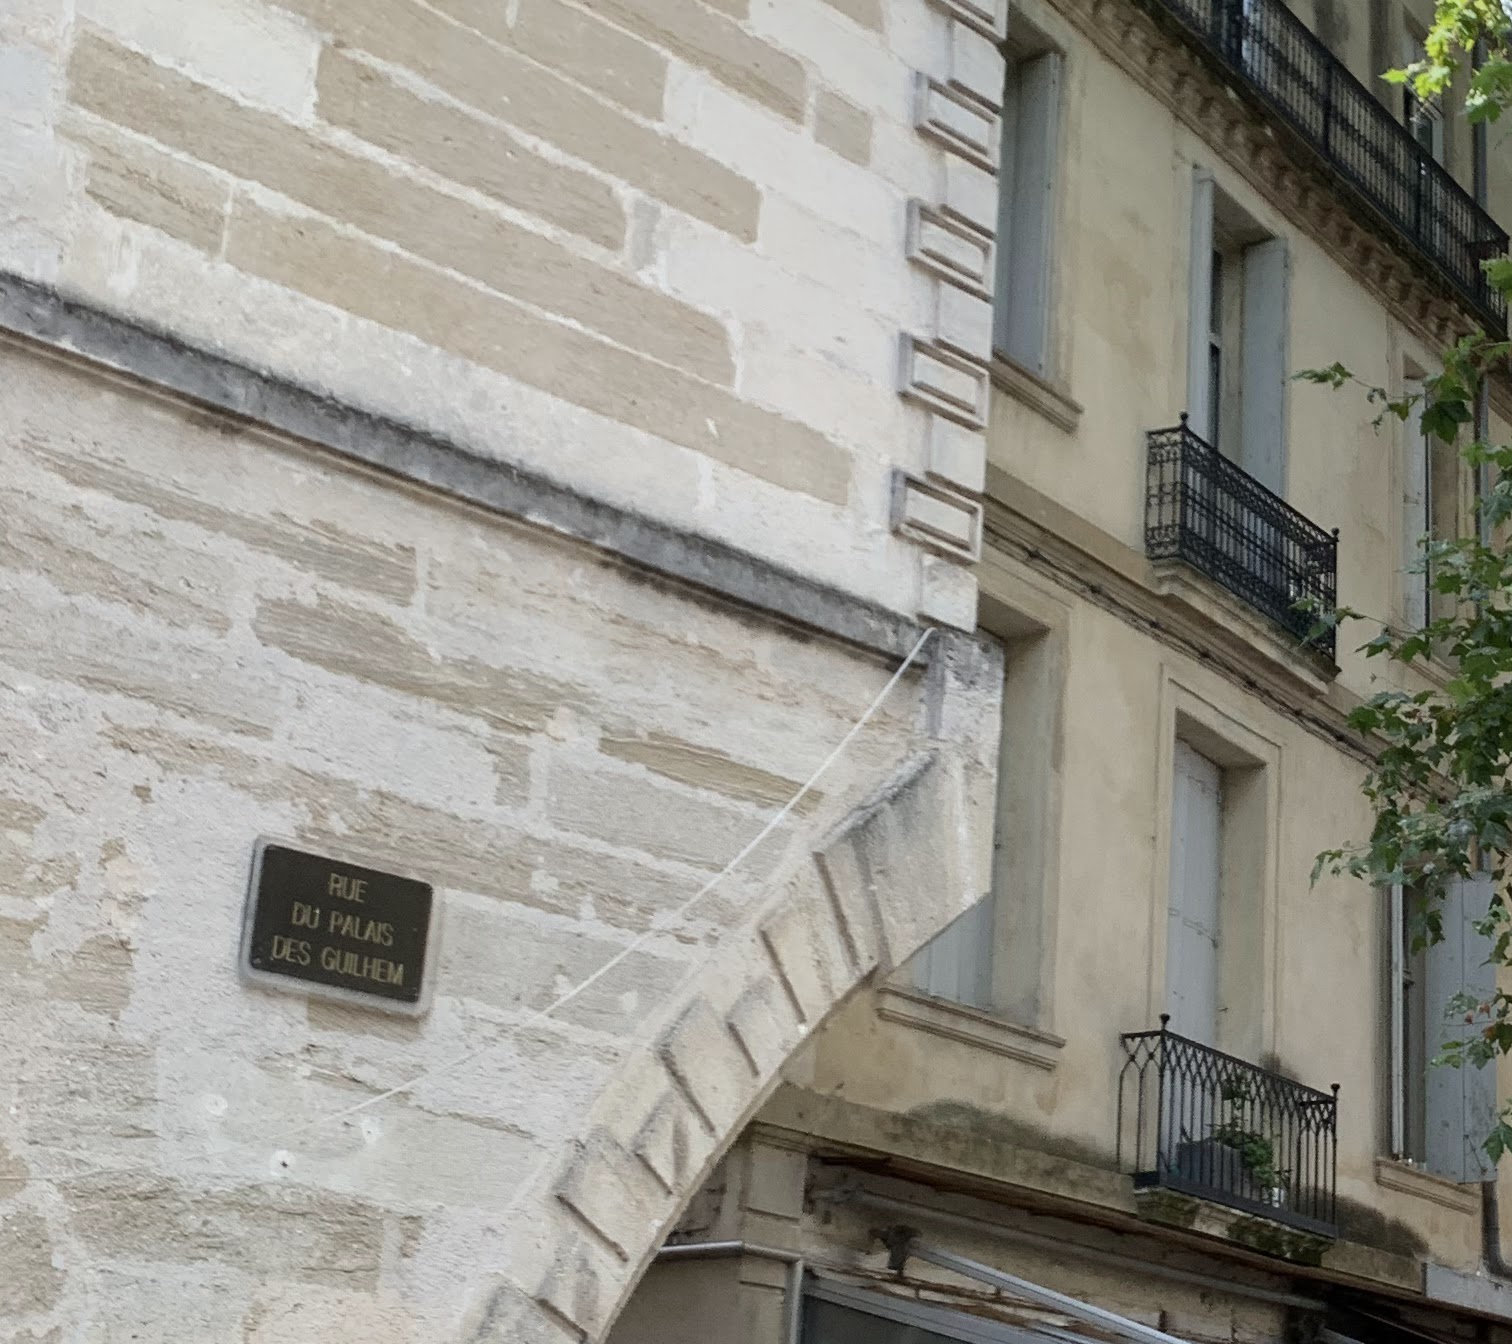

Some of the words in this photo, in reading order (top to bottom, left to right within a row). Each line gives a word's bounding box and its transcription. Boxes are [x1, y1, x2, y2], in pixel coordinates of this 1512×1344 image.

[328, 873, 368, 903] RUE
[291, 902, 320, 929] DU
[329, 911, 394, 946] PALAIS
[271, 935, 311, 966] DES
[320, 947, 404, 986] GUILHEM
